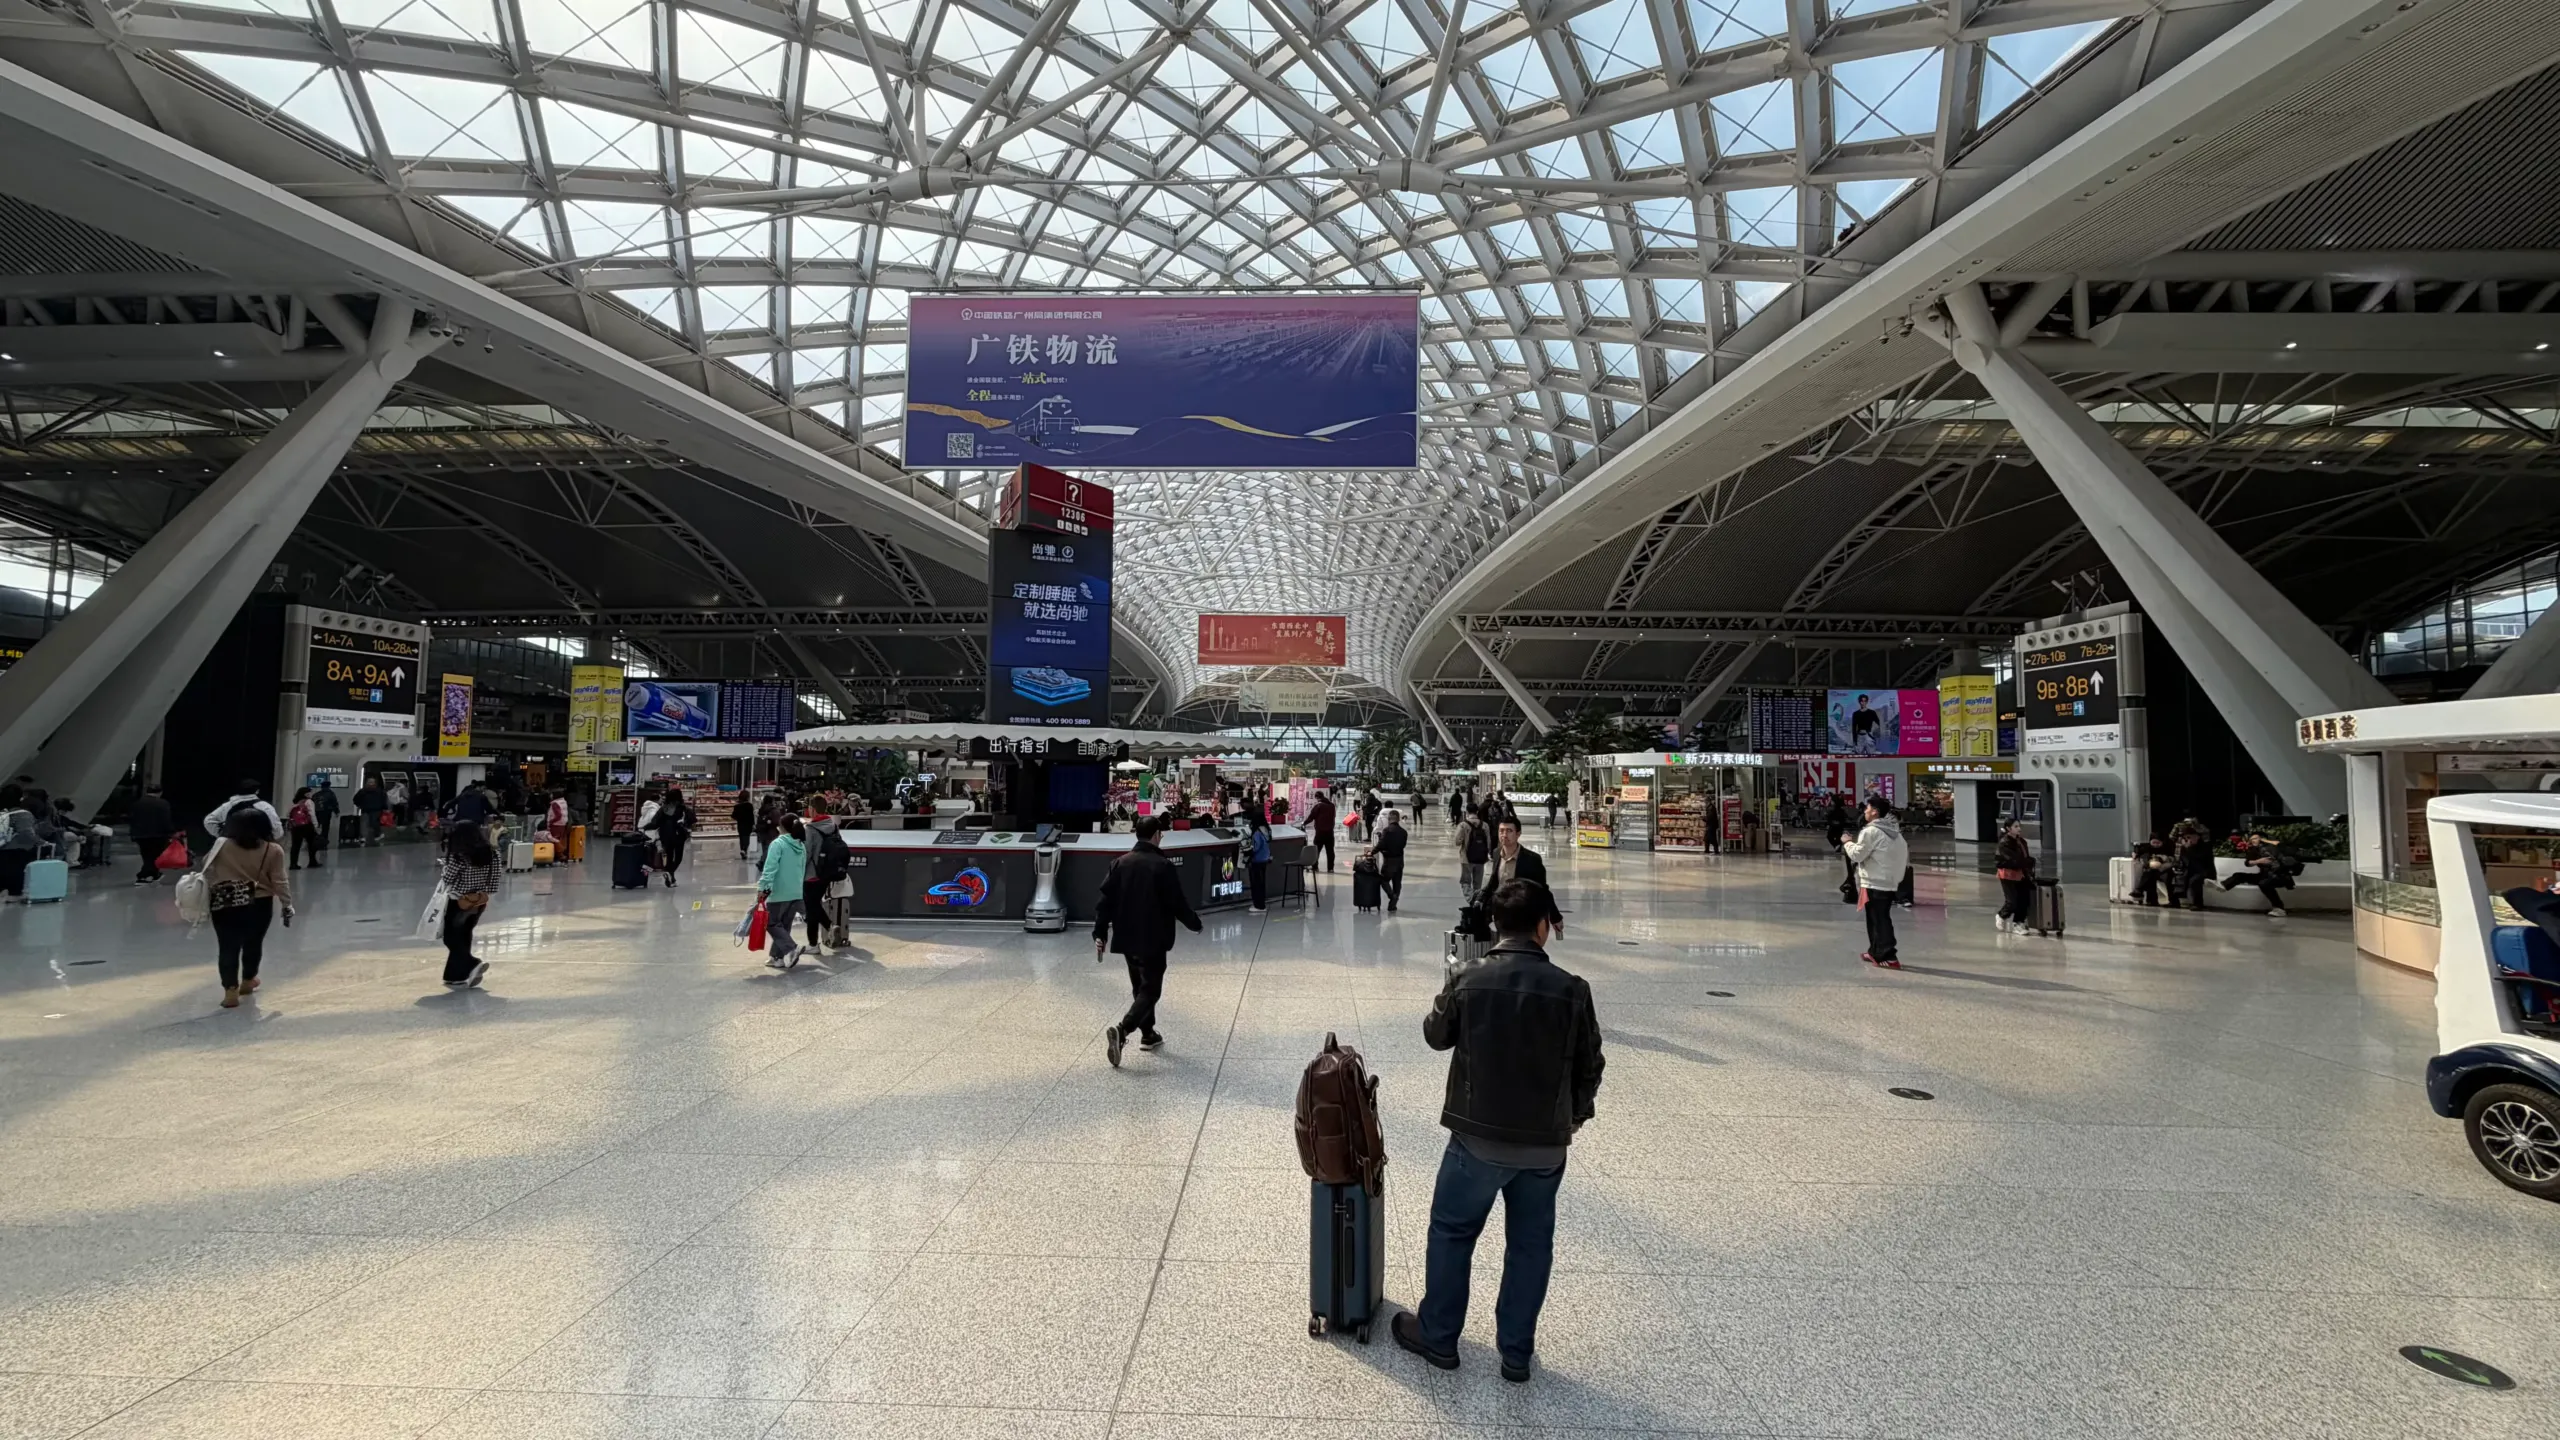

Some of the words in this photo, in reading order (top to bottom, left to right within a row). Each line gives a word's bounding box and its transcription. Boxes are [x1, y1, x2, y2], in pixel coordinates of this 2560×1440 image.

[966, 333, 1118, 365] 广铁物流
[1061, 507, 1086, 523] 12306
[1032, 543, 1056, 557] 尚驰
[1012, 583, 1077, 602] 定制睡眠
[1023, 601, 1089, 622] 就选尚驰
[323, 632, 354, 647] 1A-7A
[372, 639, 412, 654] 10A-28A
[2080, 643, 2108, 658] 7B-2B
[2031, 651, 2066, 666] 27B-10B
[1046, 717, 1059, 725] 400
[1060, 717, 1074, 725] 900
[1074, 717, 1091, 726] 5889
[989, 739, 1049, 754] 出行指引
[1077, 742, 1118, 757] 自助查询
[1684, 752, 1764, 766] 新力有家便利店
